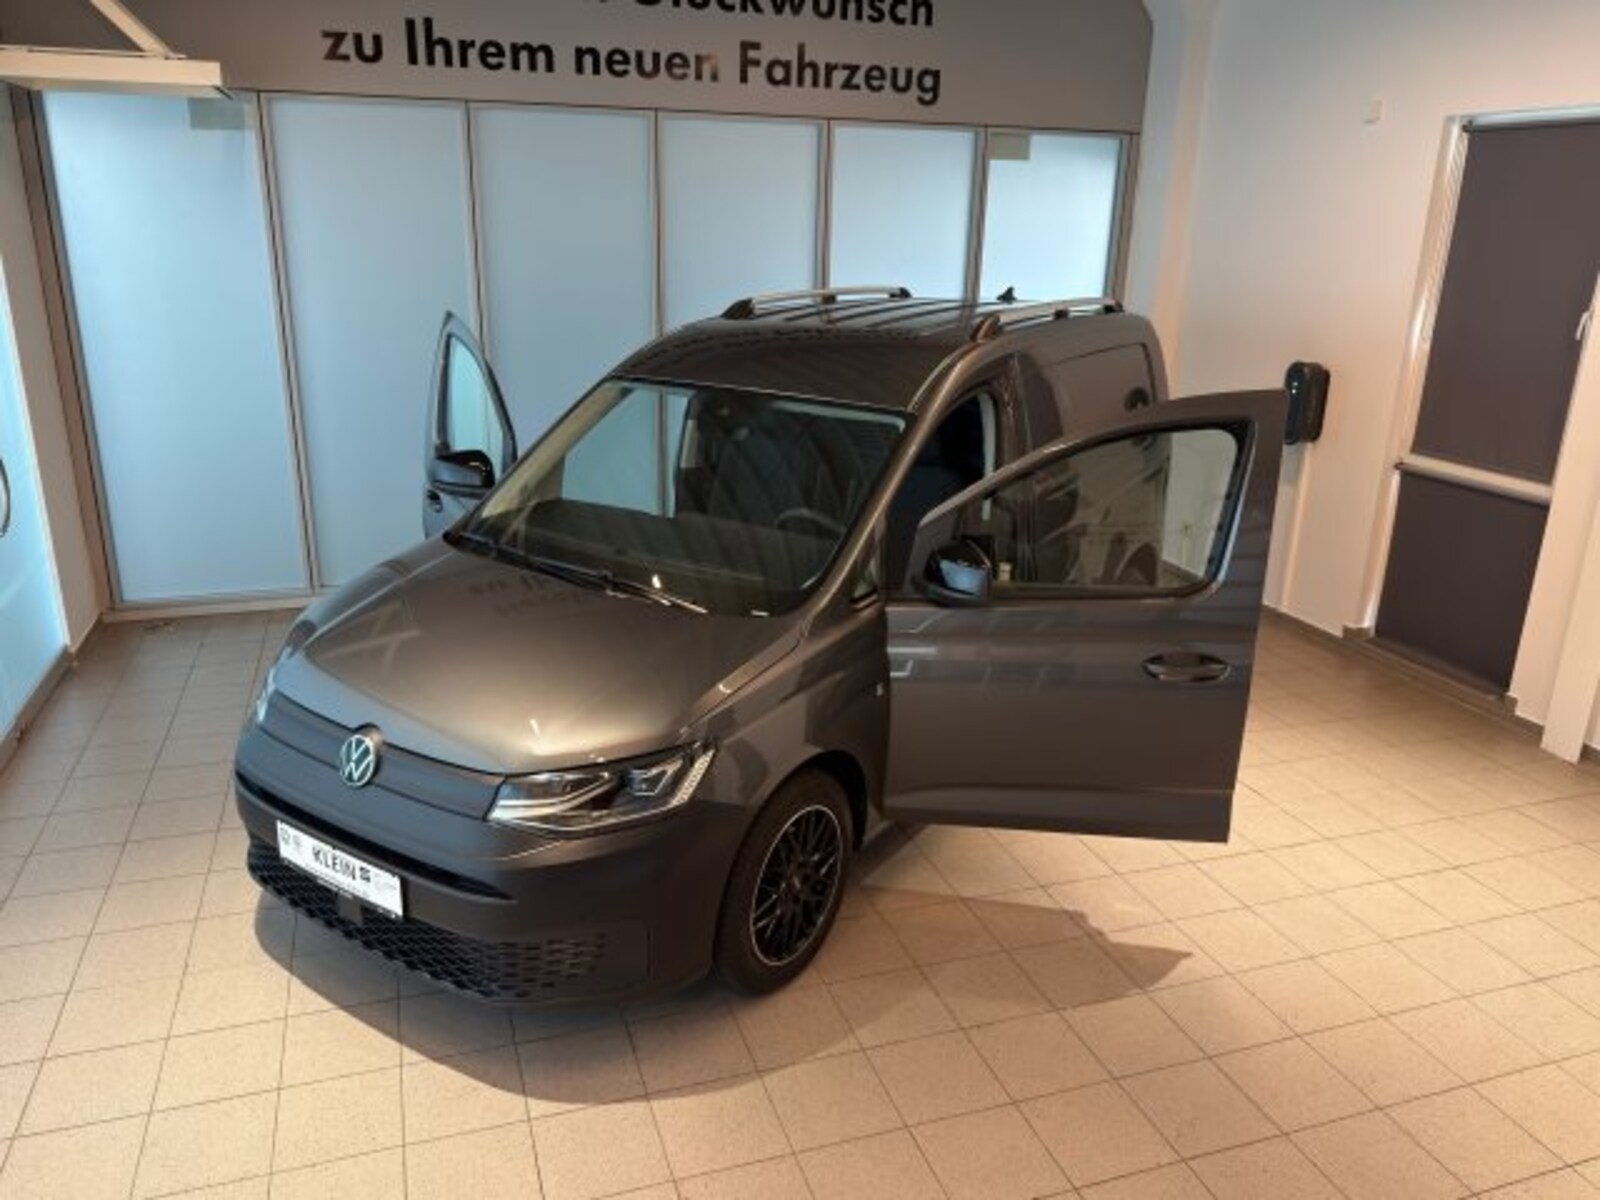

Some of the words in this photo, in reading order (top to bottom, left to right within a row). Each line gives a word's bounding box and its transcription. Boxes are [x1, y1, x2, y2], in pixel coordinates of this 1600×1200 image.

[320, 30, 384, 65] zu
[404, 16, 556, 75] Ihrem
[573, 45, 720, 84] neuen
[738, 40, 942, 107] Fahrzeug
